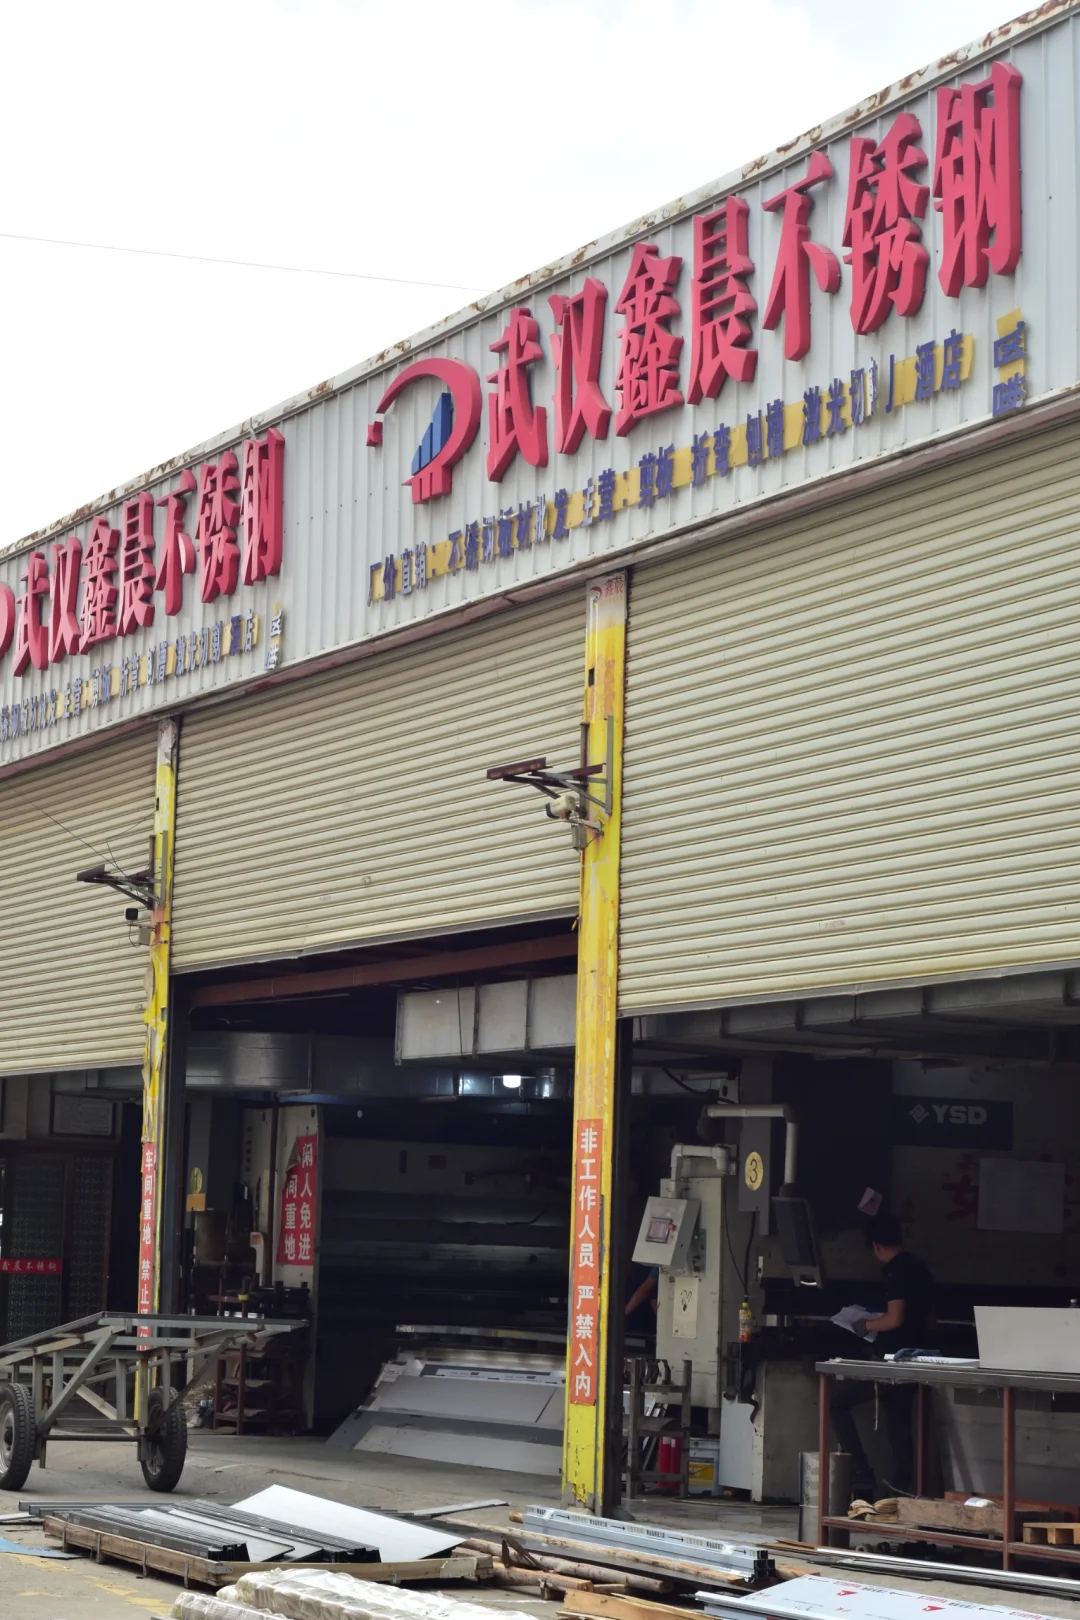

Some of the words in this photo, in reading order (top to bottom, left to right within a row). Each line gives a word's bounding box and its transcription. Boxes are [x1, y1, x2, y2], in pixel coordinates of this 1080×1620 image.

[486, 60, 1024, 482] 武汉鑫晨不锈钢
[914, 328, 963, 403] 酒店
[14, 427, 285, 678] 武汉鑫晨不锈钢
[931, 1104, 988, 1125] YSD
[142, 1149, 153, 1246] 车间重地
[284, 1174, 298, 1261] 间重地
[298, 1142, 314, 1261] 闲人免进
[577, 1128, 598, 1269] 非工作人员
[749, 1158, 758, 1184] 3
[573, 1284, 595, 1399] 严禁入内
